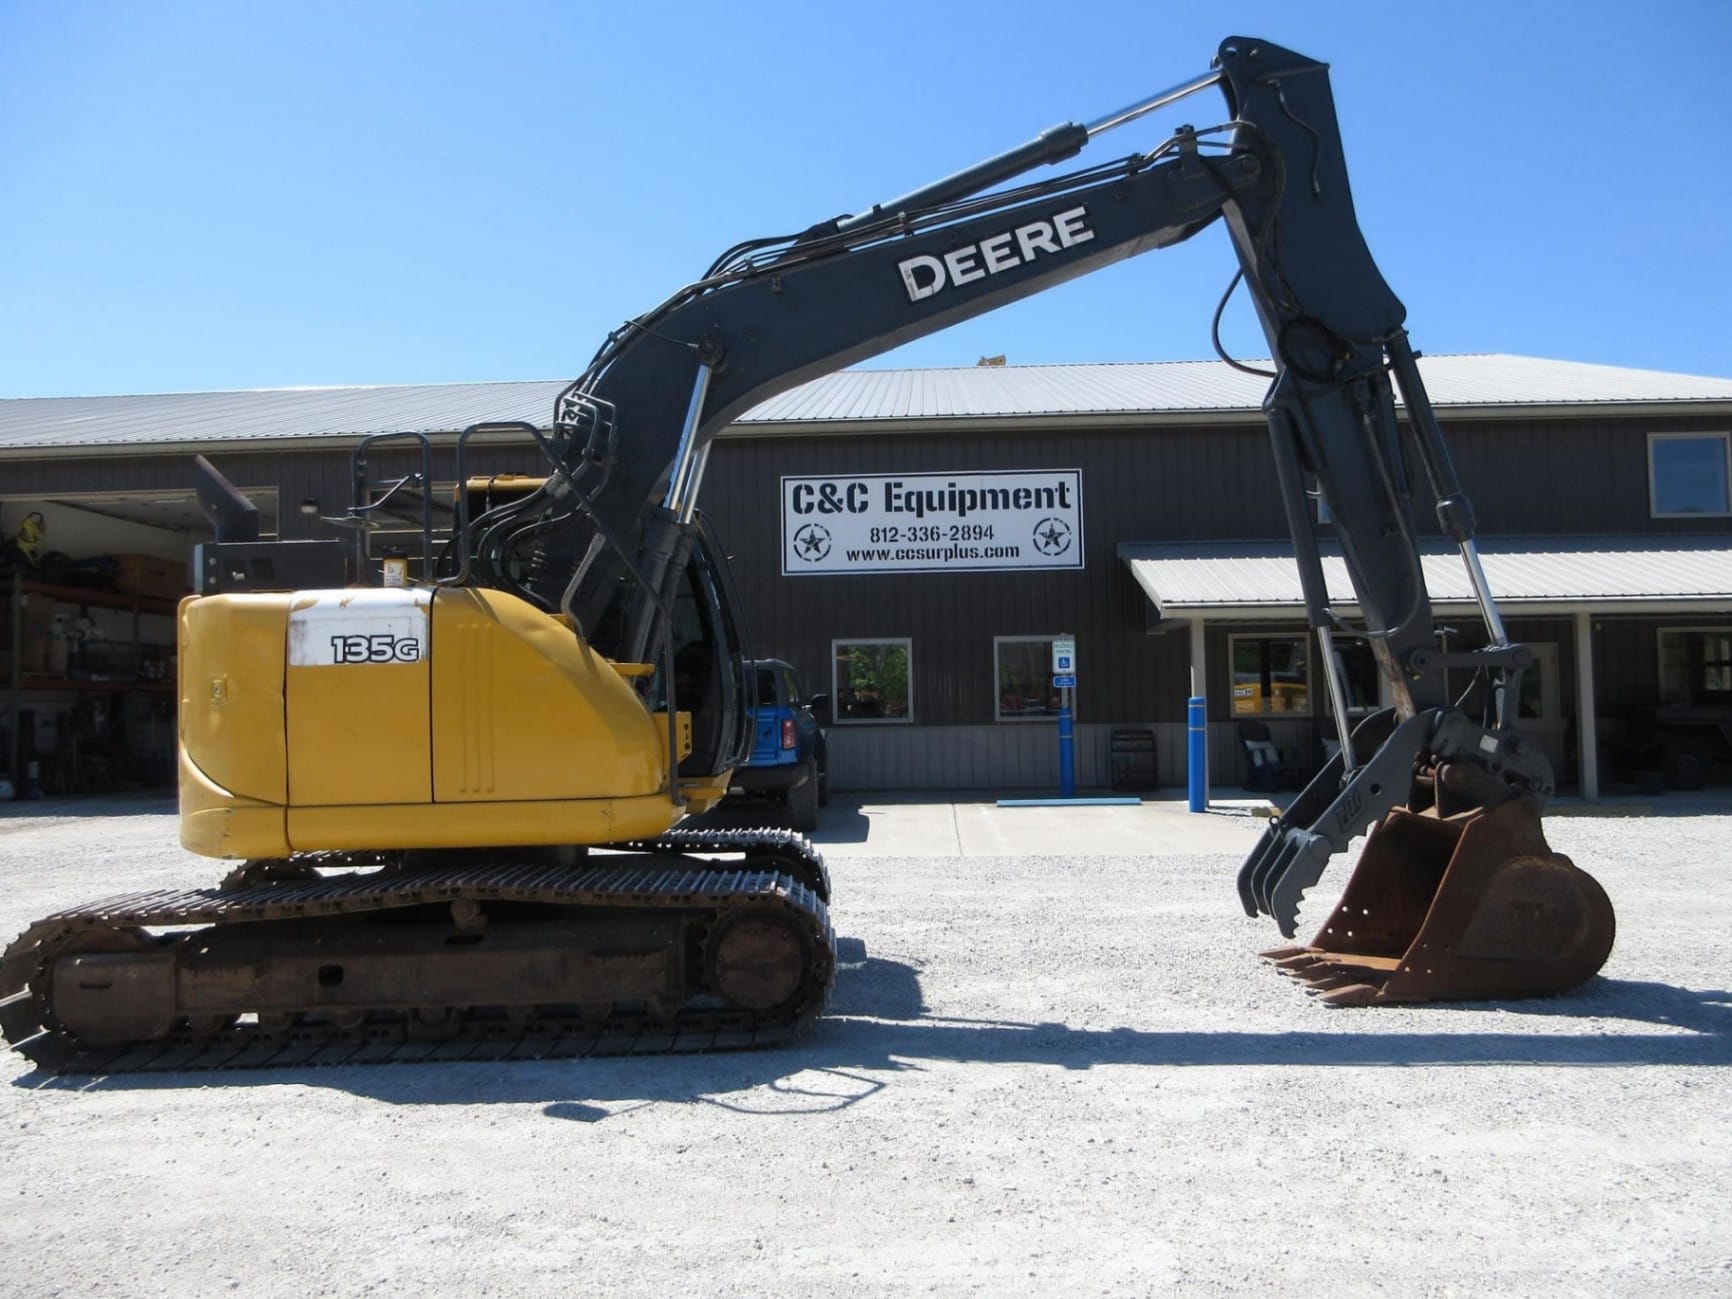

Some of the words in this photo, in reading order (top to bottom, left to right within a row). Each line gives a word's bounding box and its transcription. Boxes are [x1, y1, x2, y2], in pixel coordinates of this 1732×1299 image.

[898, 206, 1095, 301] DEERE
[793, 483, 869, 514] C&C
[884, 481, 1071, 518] Equipment
[870, 525, 994, 543] 812-336-2894
[846, 543, 1020, 562] www.ccsurplus.com
[331, 635, 419, 663] 135G
